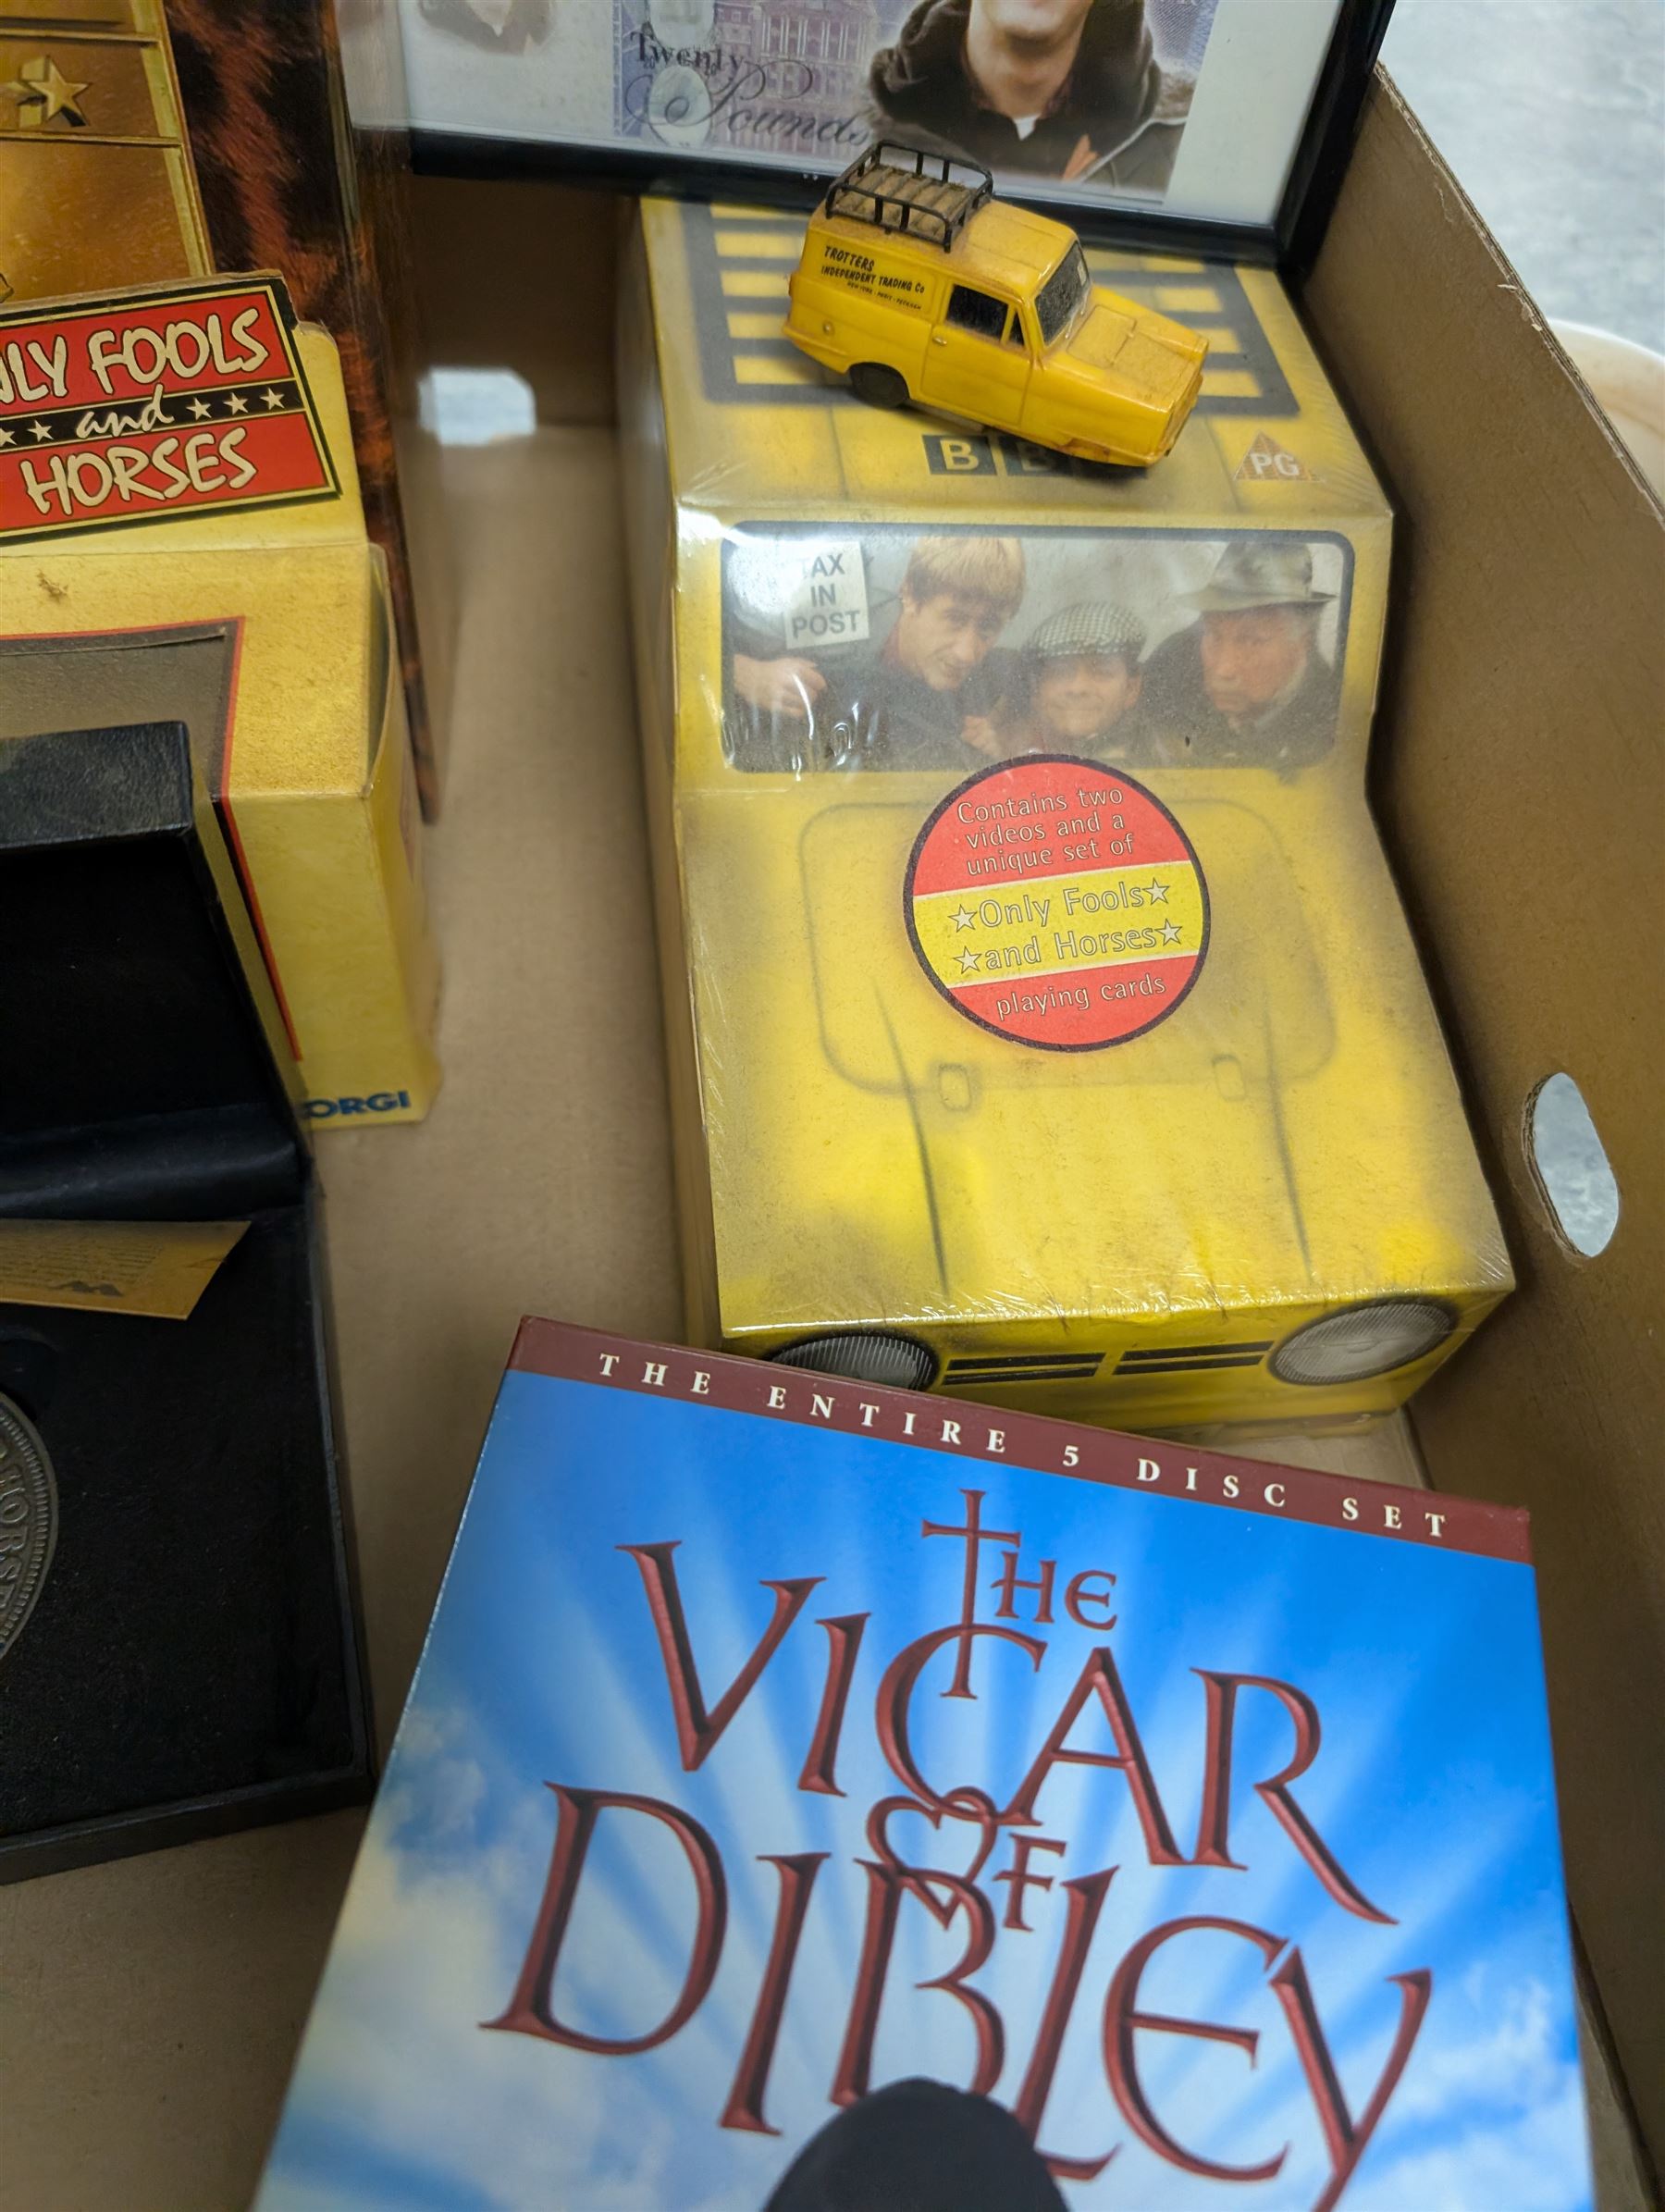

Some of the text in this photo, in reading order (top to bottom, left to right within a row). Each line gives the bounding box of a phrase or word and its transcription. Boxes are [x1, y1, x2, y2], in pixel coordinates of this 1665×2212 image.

[821, 266, 877, 285] INDEPENDENT
[879, 276, 912, 292] TRADING
[824, 245, 875, 272] TROTTERS
[88, 306, 269, 395] FOOLS
[75, 383, 174, 440] and
[19, 426, 259, 516] HORSES
[1249, 451, 1301, 477] PG
[809, 583, 837, 608] IN
[791, 610, 861, 640] POST
[956, 787, 1124, 824] Contains two
[966, 811, 1125, 850] videos and a
[967, 833, 1135, 876] unique set of
[979, 881, 1144, 928] Only Fools
[984, 926, 1157, 971] and Horses
[995, 973, 1167, 1021] playing cards
[303, 1091, 410, 1118] ORGI
[599, 1352, 1447, 1539] THE ENTIRE 5 DISC SET
[920, 1489, 1119, 1700] THE
[615, 1540, 1400, 1926] VICAR
[867, 1786, 1067, 1932] OF
[478, 1781, 1433, 2212] DIBLEY
